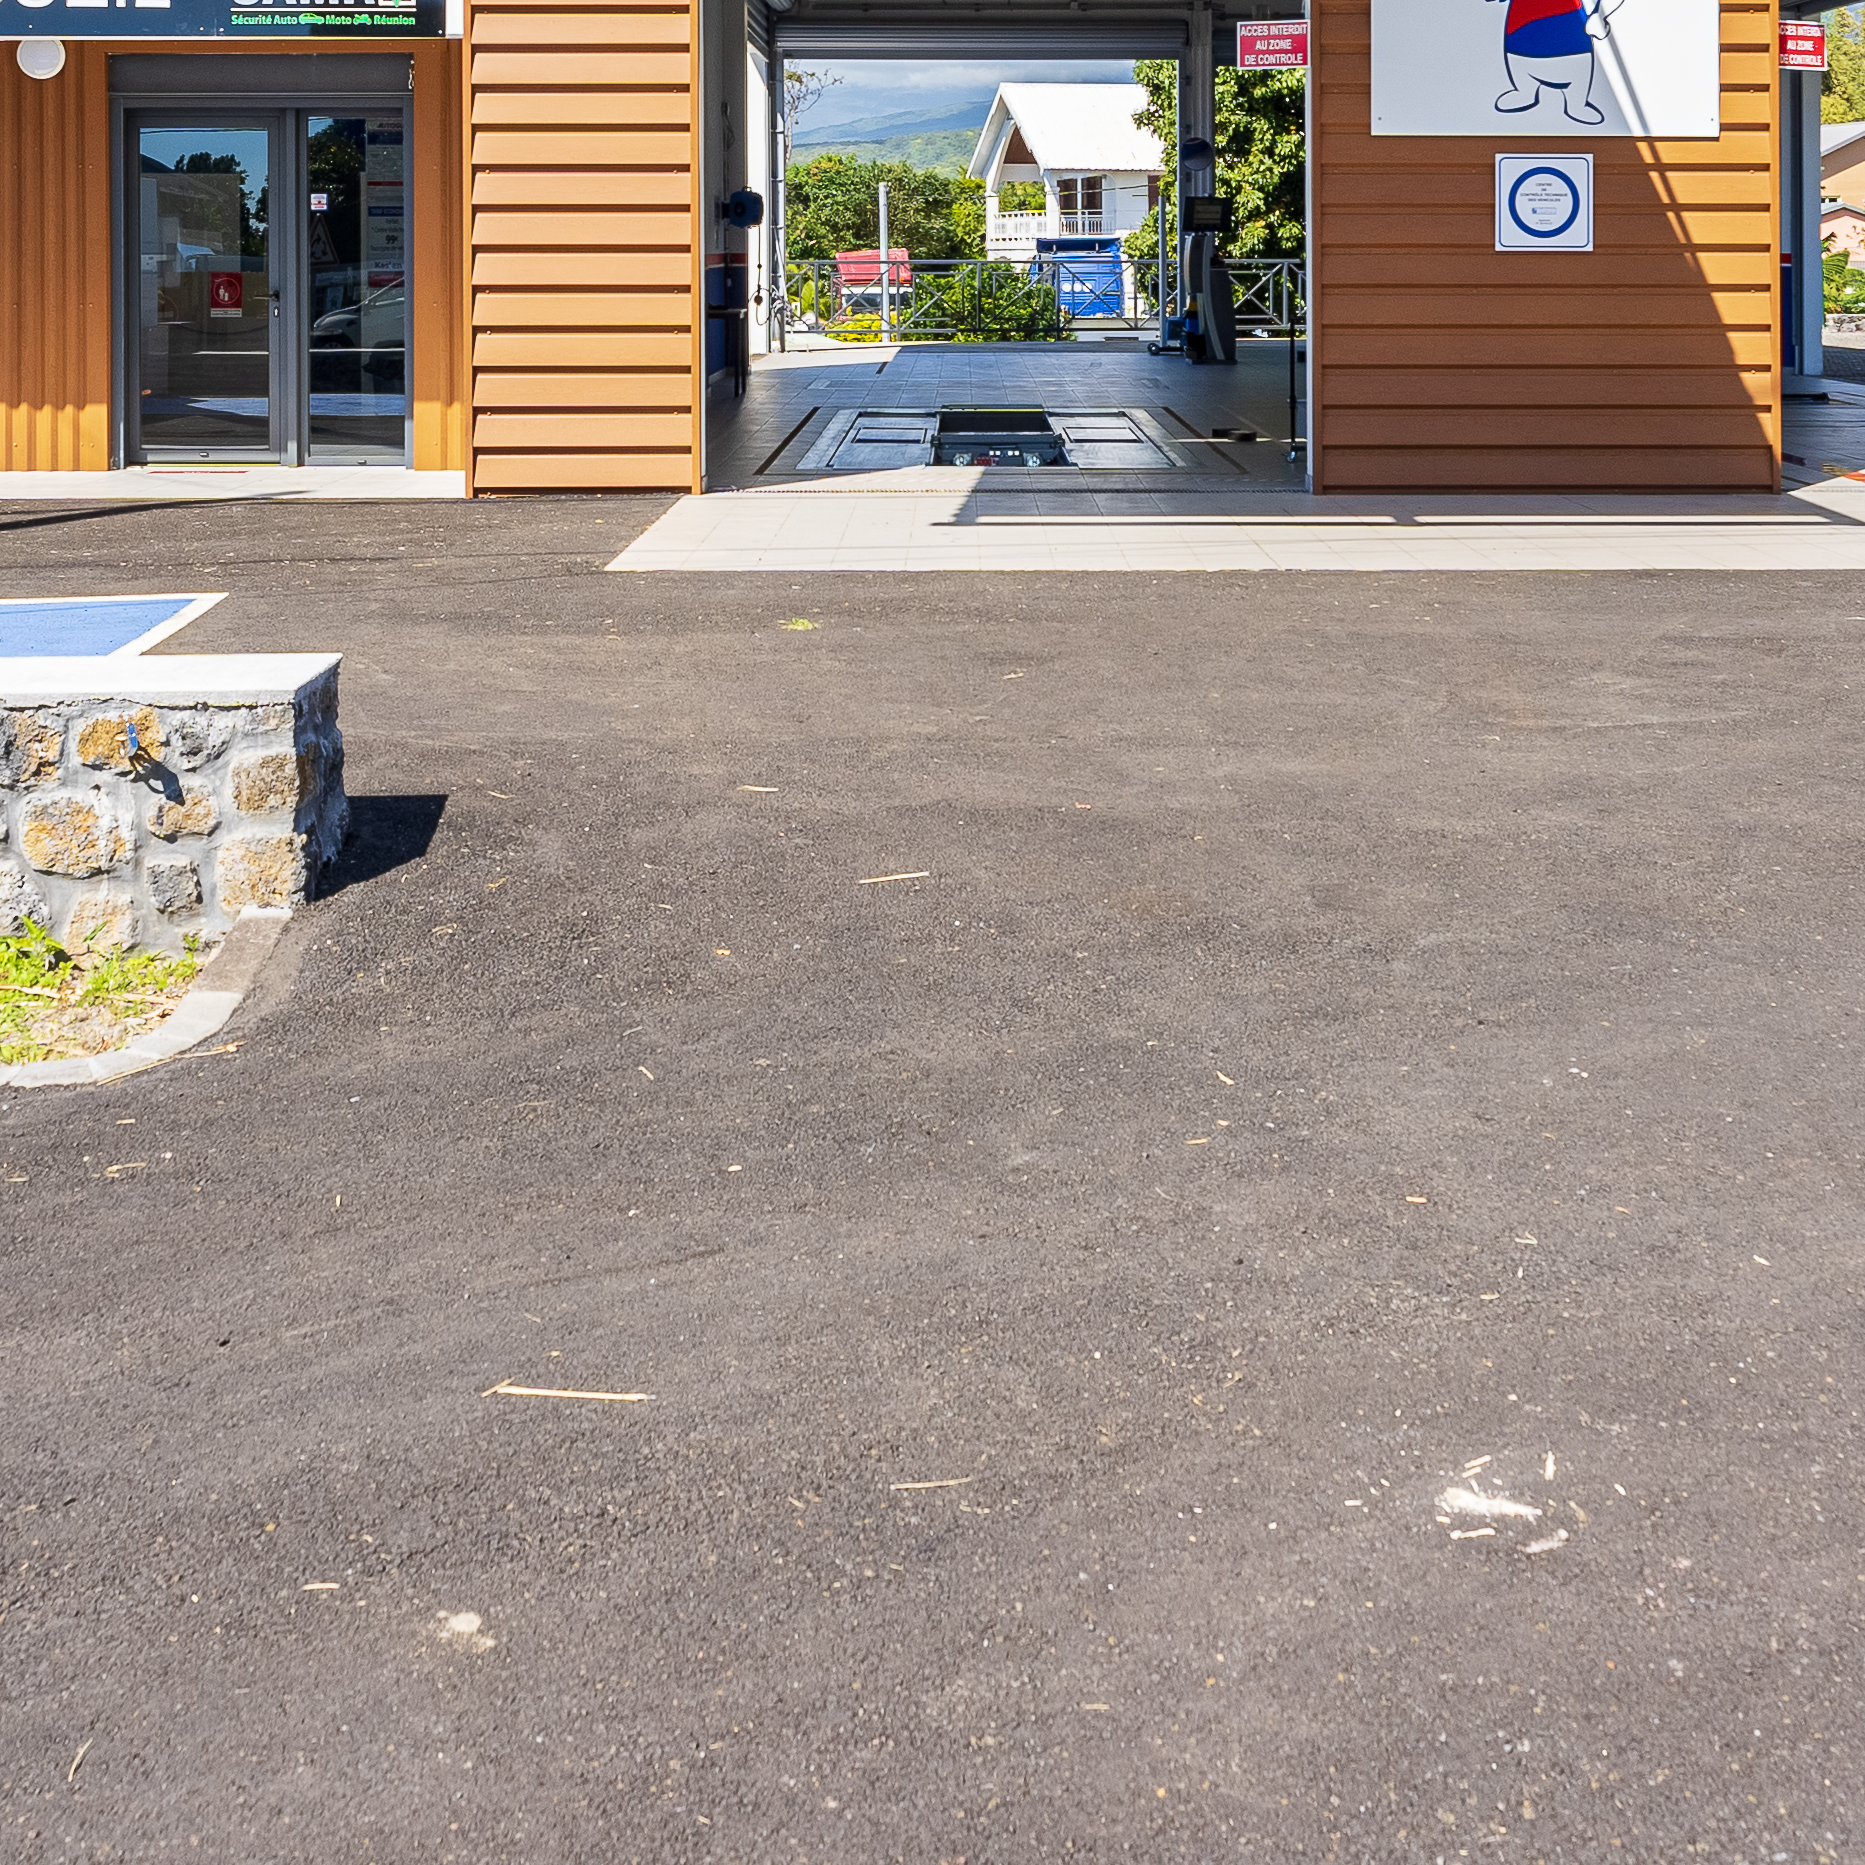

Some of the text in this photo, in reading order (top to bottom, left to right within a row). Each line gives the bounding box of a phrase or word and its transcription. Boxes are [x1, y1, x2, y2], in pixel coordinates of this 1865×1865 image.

[230, 13, 416, 26] Sécurité Auto Moto Réunion
[1240, 24, 1308, 36] ACCES INTERDIT
[1779, 25, 1797, 36] CCES
[1255, 39, 1292, 50] AU ZONE
[1244, 53, 1304, 65] DE CONTROLE
